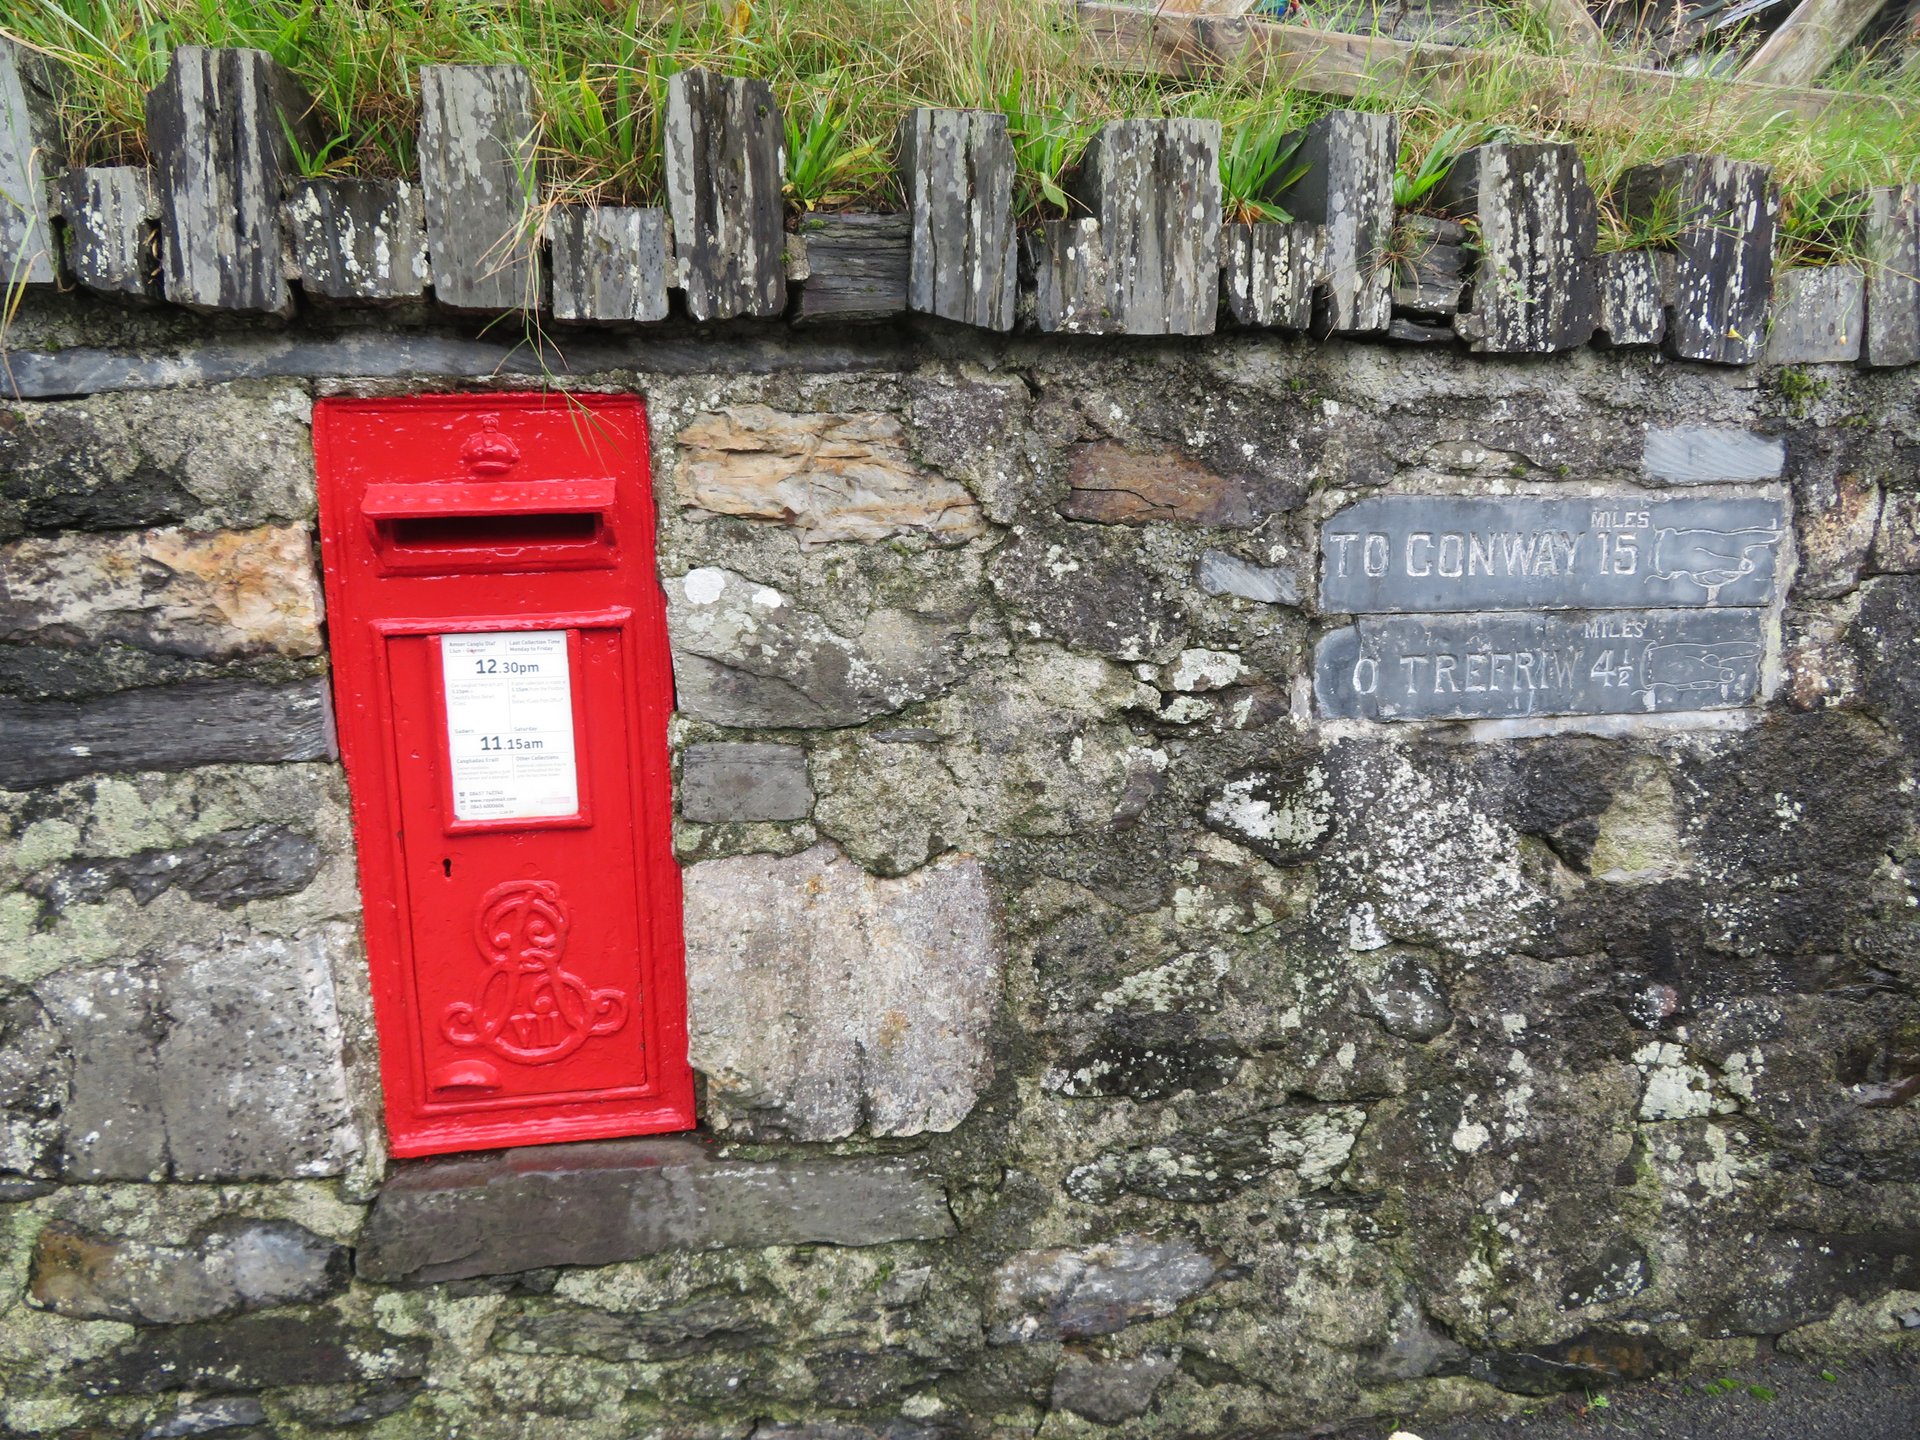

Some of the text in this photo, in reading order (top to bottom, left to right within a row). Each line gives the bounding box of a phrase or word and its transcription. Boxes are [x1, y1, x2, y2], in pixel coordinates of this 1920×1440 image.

[1591, 511, 1650, 528] MILES
[1330, 531, 1637, 578] TO CONWAY 15
[1585, 620, 1647, 639] MILES
[475, 659, 539, 675] 12.30pm
[1400, 650, 1582, 695] TREFRIW
[480, 736, 543, 751] 11.15am
